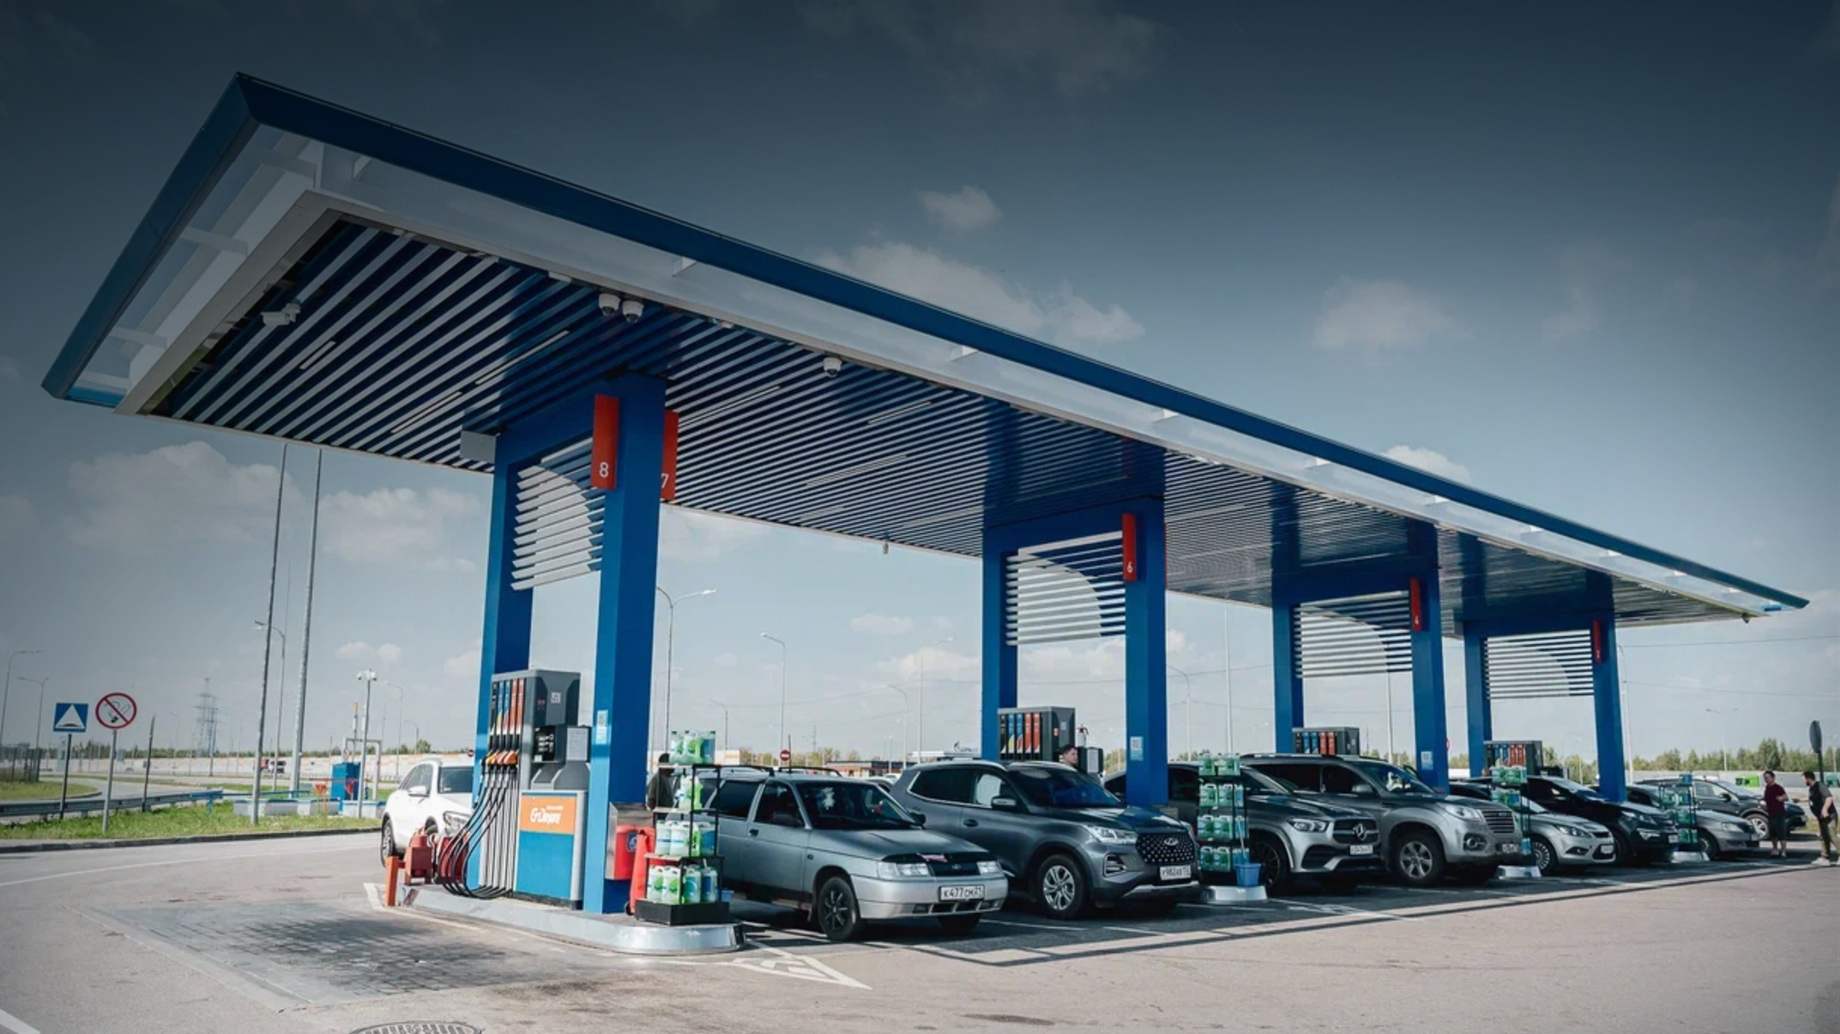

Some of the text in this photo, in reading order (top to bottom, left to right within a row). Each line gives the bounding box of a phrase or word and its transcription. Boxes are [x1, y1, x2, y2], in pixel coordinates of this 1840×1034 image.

[599, 461, 609, 478] 8
[661, 473, 669, 488] 7
[1126, 560, 1133, 573] 6
